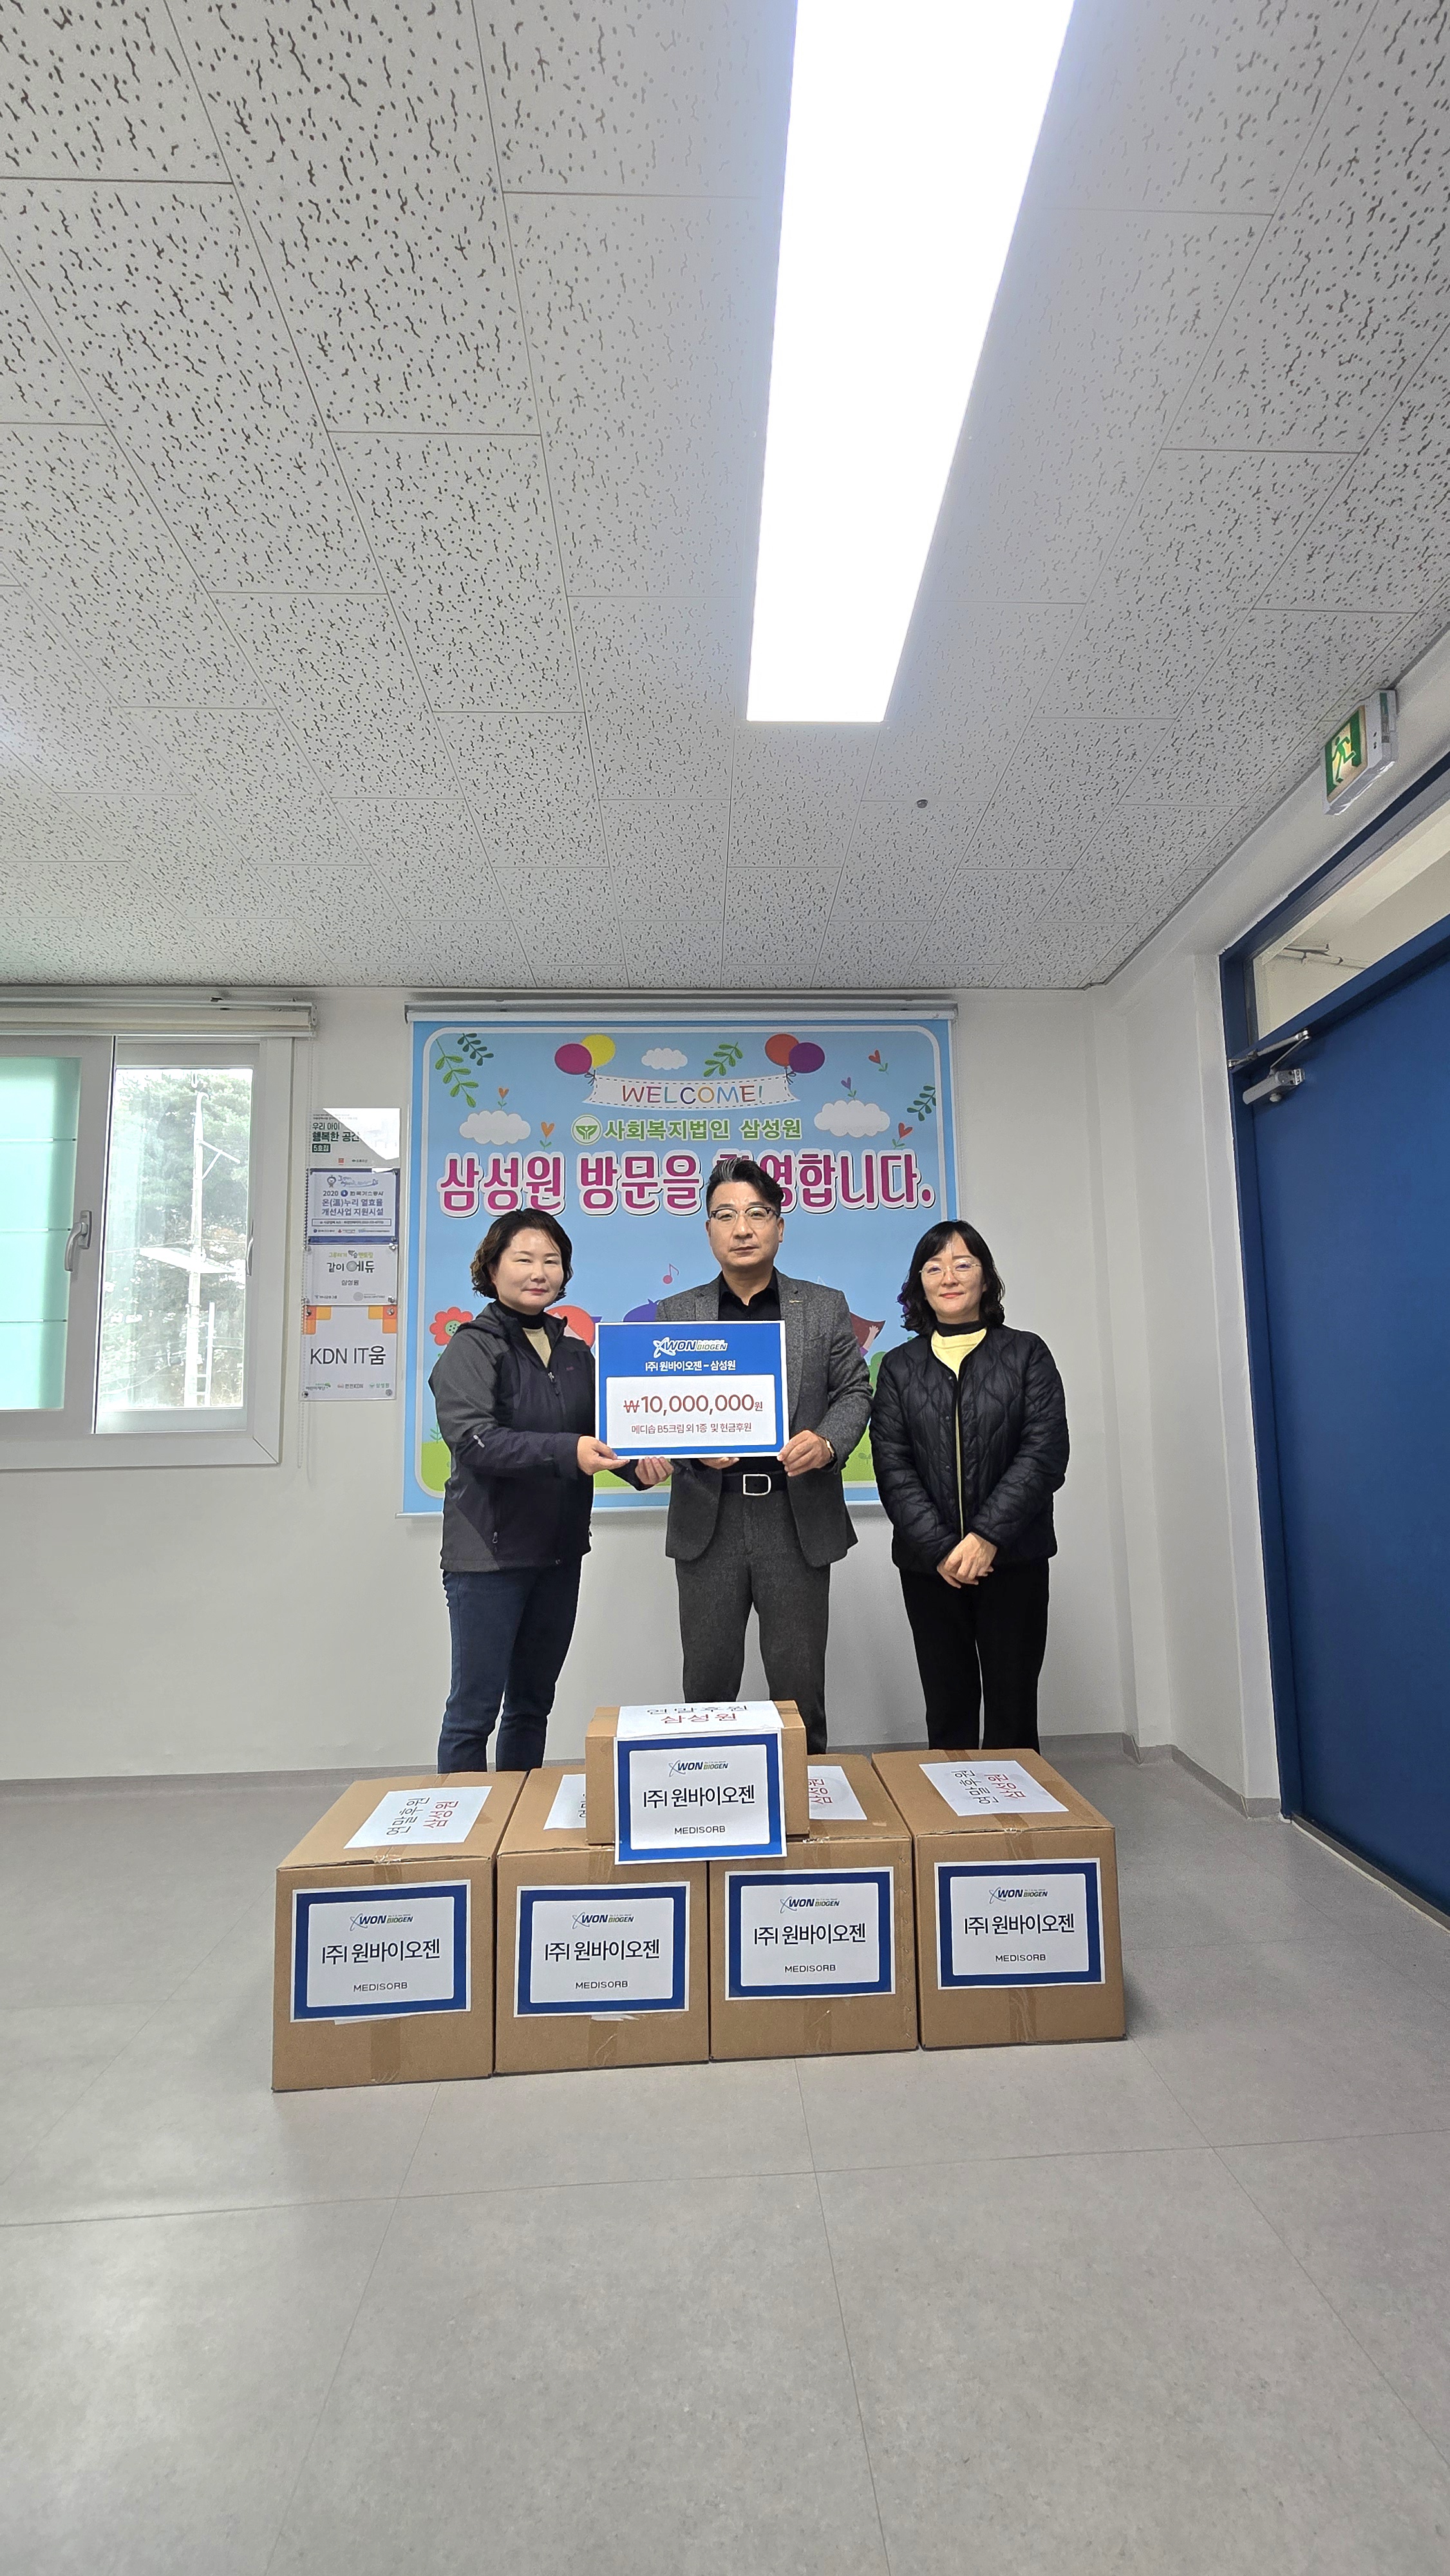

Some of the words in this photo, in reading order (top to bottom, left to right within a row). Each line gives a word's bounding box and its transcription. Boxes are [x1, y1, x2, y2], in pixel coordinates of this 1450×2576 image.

[622, 1084, 762, 1104] WELCOME!
[604, 1119, 730, 1141] 사회복지법인
[740, 1118, 802, 1140] 삼성원
[312, 1132, 339, 1142] 행복한
[440, 1155, 562, 1211] 삼성원
[580, 1155, 699, 1211] 방문을
[716, 1153, 936, 1210] 영합니다.
[322, 1208, 352, 1216] 개선사업
[353, 1208, 384, 1216] 지원시설
[310, 1348, 348, 1364] KDN
[710, 1359, 736, 1370] 삼성원
[710, 1423, 719, 1433] 및
[674, 1825, 726, 1835] MEDISORB
[386, 1916, 413, 1924] BIOGEN
[995, 1953, 1046, 1962] MEDISORB
[784, 1964, 836, 1973] MEDISORB
[353, 1982, 408, 1993] MEDISORB
[575, 1980, 628, 1990] MEDISORB
